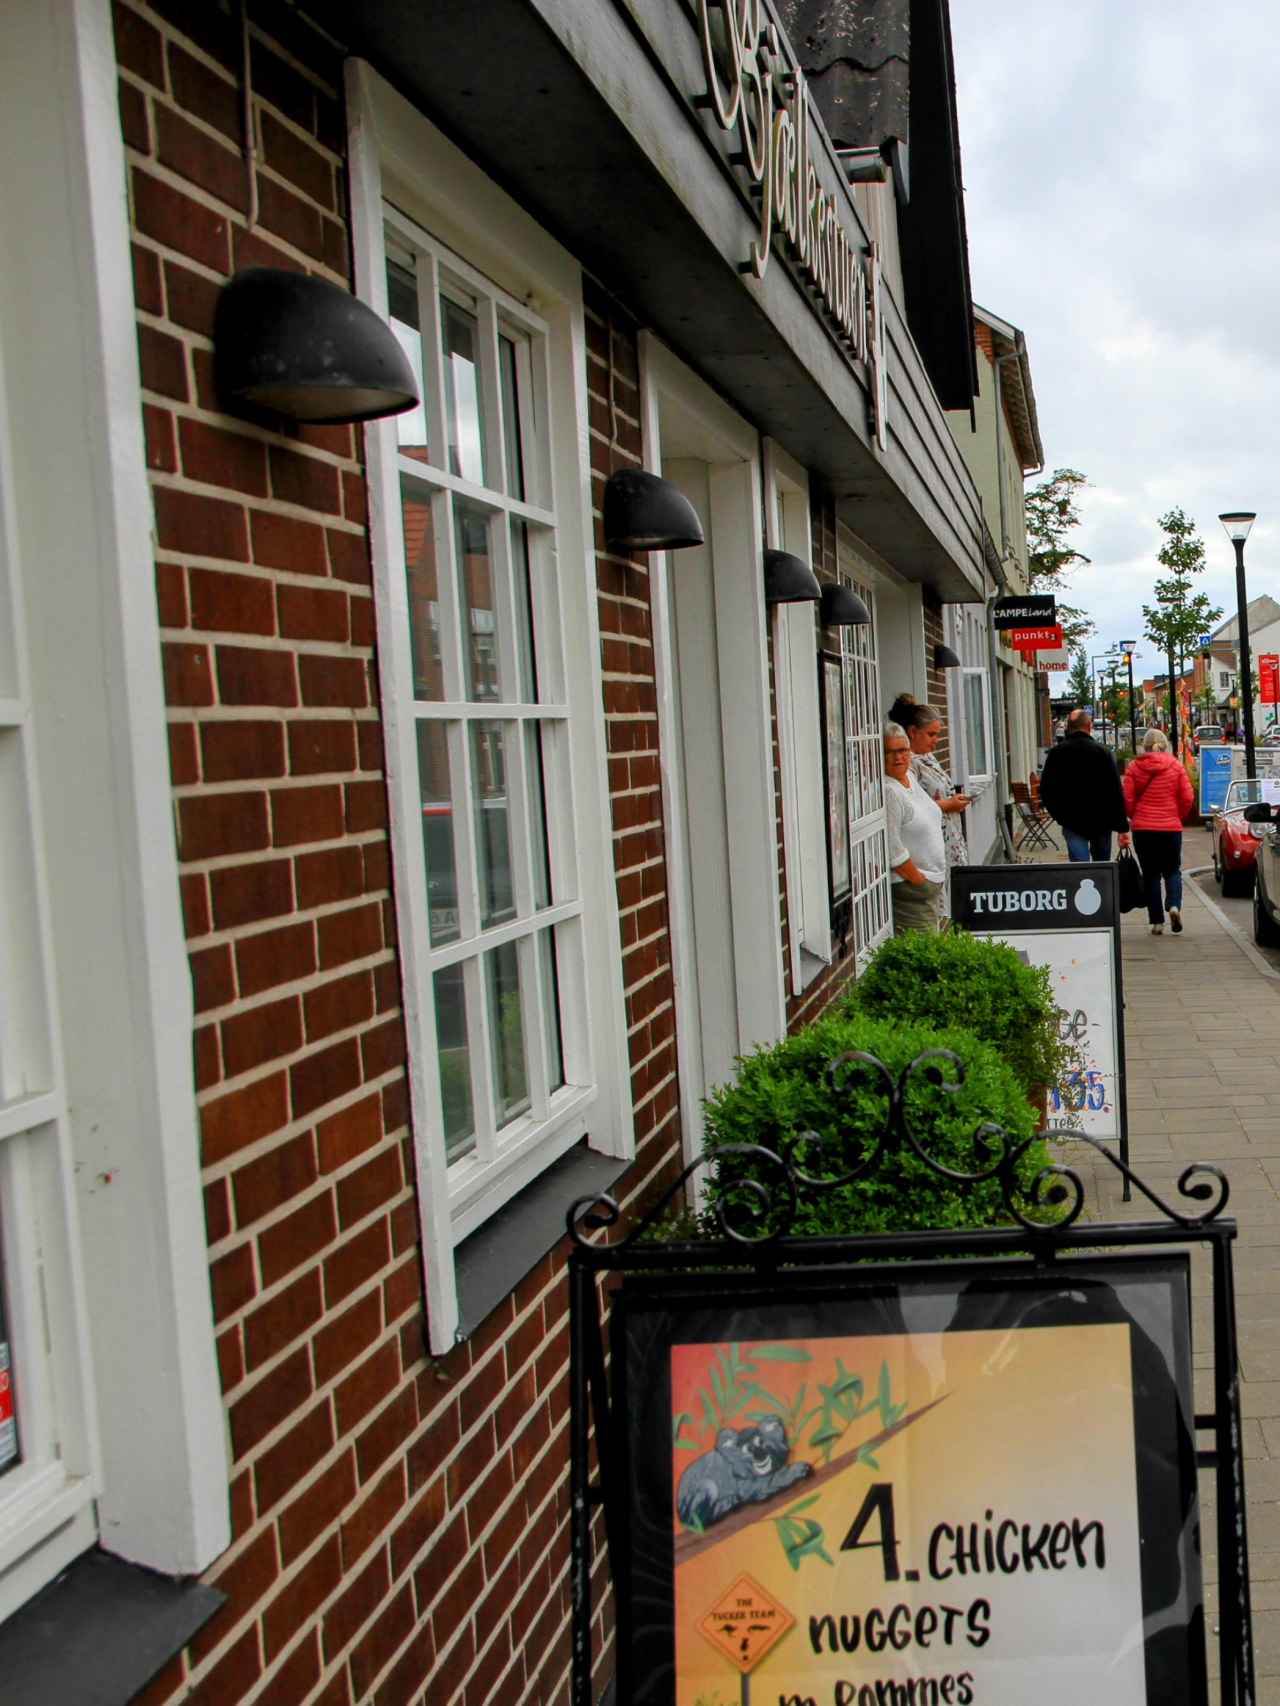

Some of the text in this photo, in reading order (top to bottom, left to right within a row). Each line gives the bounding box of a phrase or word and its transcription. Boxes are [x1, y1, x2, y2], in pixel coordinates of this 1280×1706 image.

[1039, 662, 1069, 671] home
[970, 890, 1068, 913] TUBORG
[840, 1482, 921, 1582] 4.
[735, 1598, 753, 1607] THE
[712, 1609, 776, 1621] TUCKER TEAM
